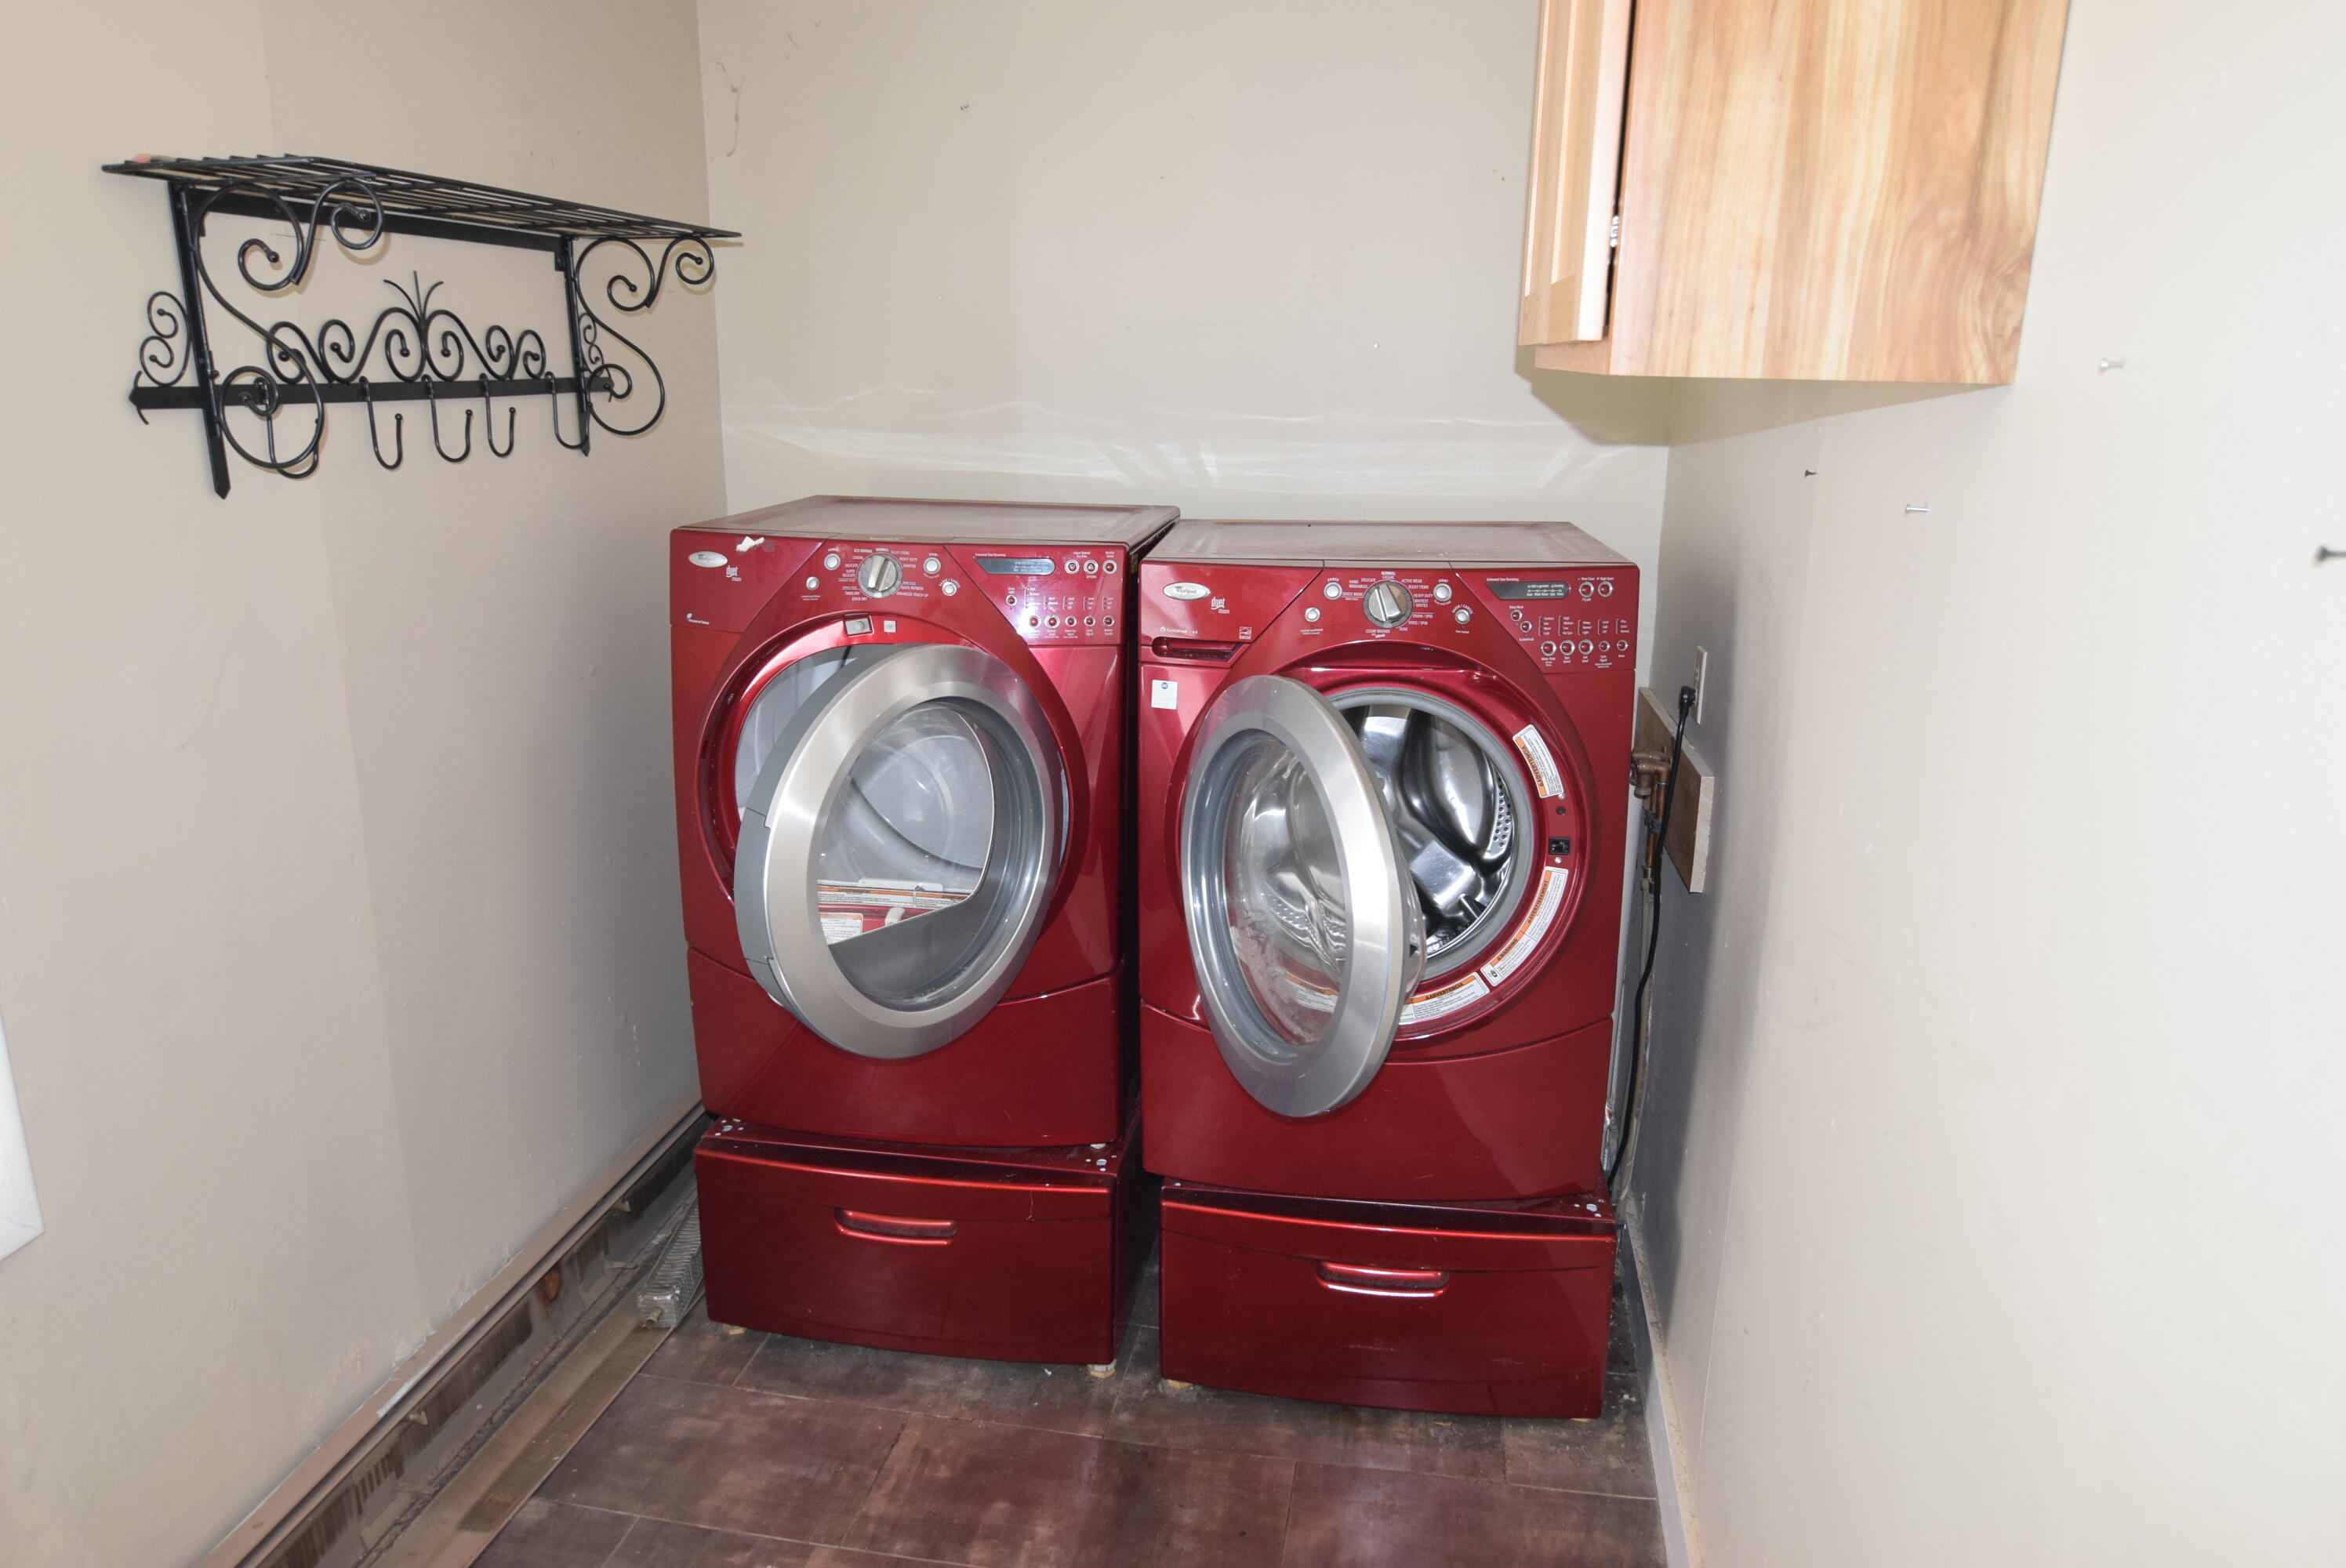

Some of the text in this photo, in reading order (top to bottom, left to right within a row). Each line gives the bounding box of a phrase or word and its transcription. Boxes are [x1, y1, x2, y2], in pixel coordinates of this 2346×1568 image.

[1211, 597, 1226, 609] duet
[1521, 746, 1544, 783] ADVERTENCIA
[1528, 880, 1549, 920] AVERTISSEMENT
[1429, 982, 1464, 1000] ADVERTENCIA
